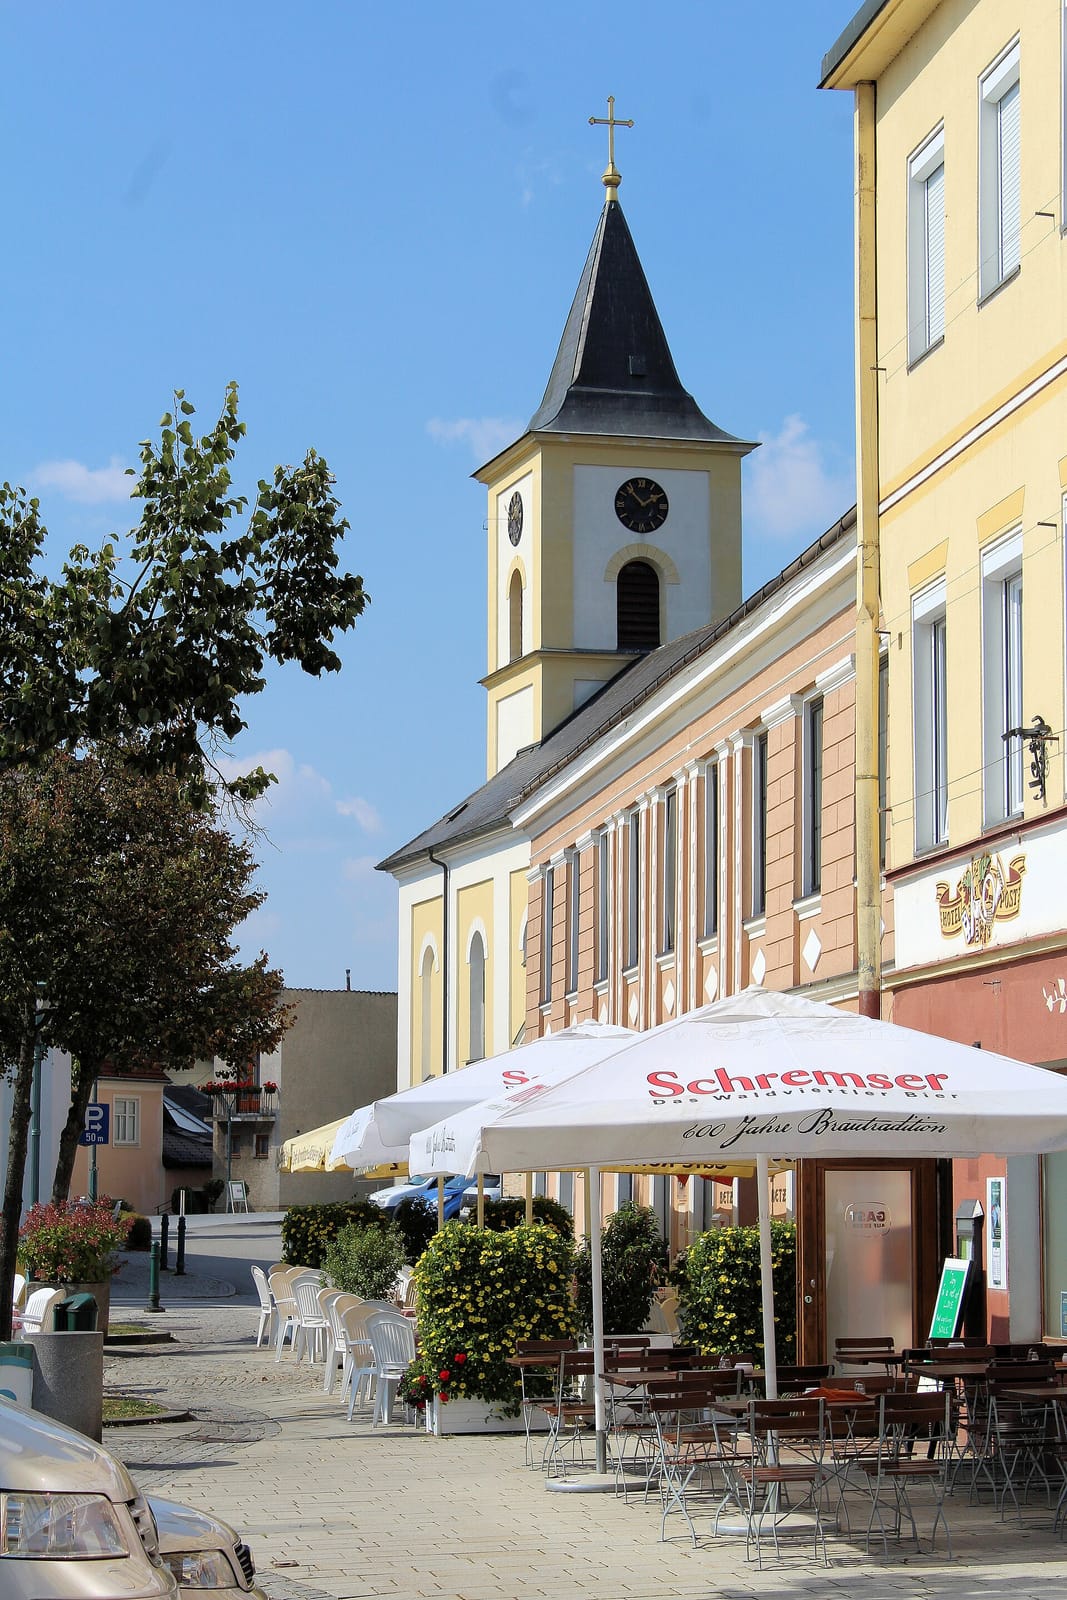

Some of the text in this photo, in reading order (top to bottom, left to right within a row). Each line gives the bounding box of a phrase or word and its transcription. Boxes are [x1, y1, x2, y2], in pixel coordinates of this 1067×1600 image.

[942, 887, 1019, 927] HOTEL POST
[646, 1067, 949, 1098] Schremser
[713, 1087, 888, 1100] Waldviertler
[904, 1091, 958, 1099] Bier
[85, 1106, 104, 1131] P
[682, 1107, 949, 1149] 600 Jahre Brautradition
[85, 1132, 96, 1142] 50
